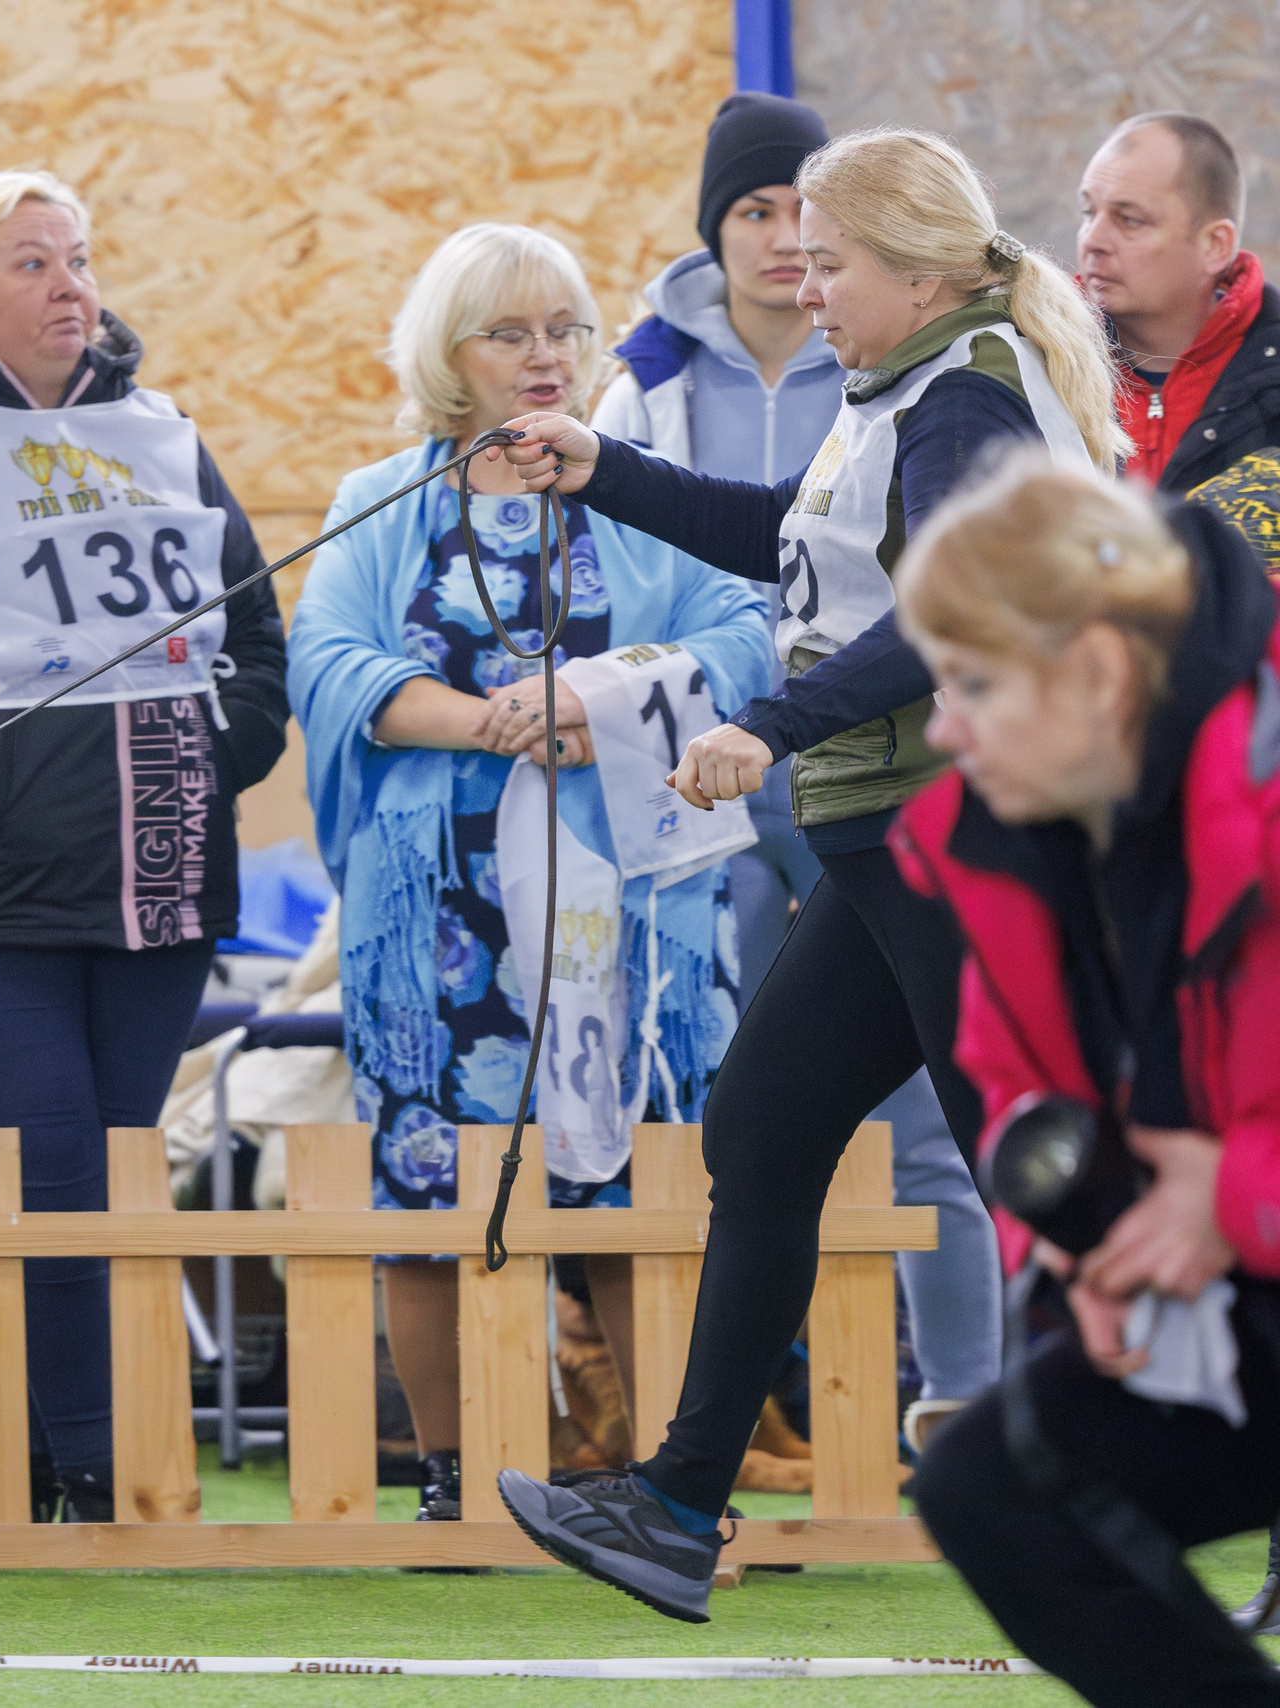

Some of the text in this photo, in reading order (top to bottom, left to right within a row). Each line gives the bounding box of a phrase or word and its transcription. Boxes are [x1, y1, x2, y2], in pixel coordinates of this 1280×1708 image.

[22, 526, 202, 626] 136
[171, 693, 195, 720] S
[177, 728, 204, 759] IT
[130, 701, 182, 948] SIGNIF
[179, 769, 208, 863] MAKE
[84, 1656, 199, 1673] Winner
